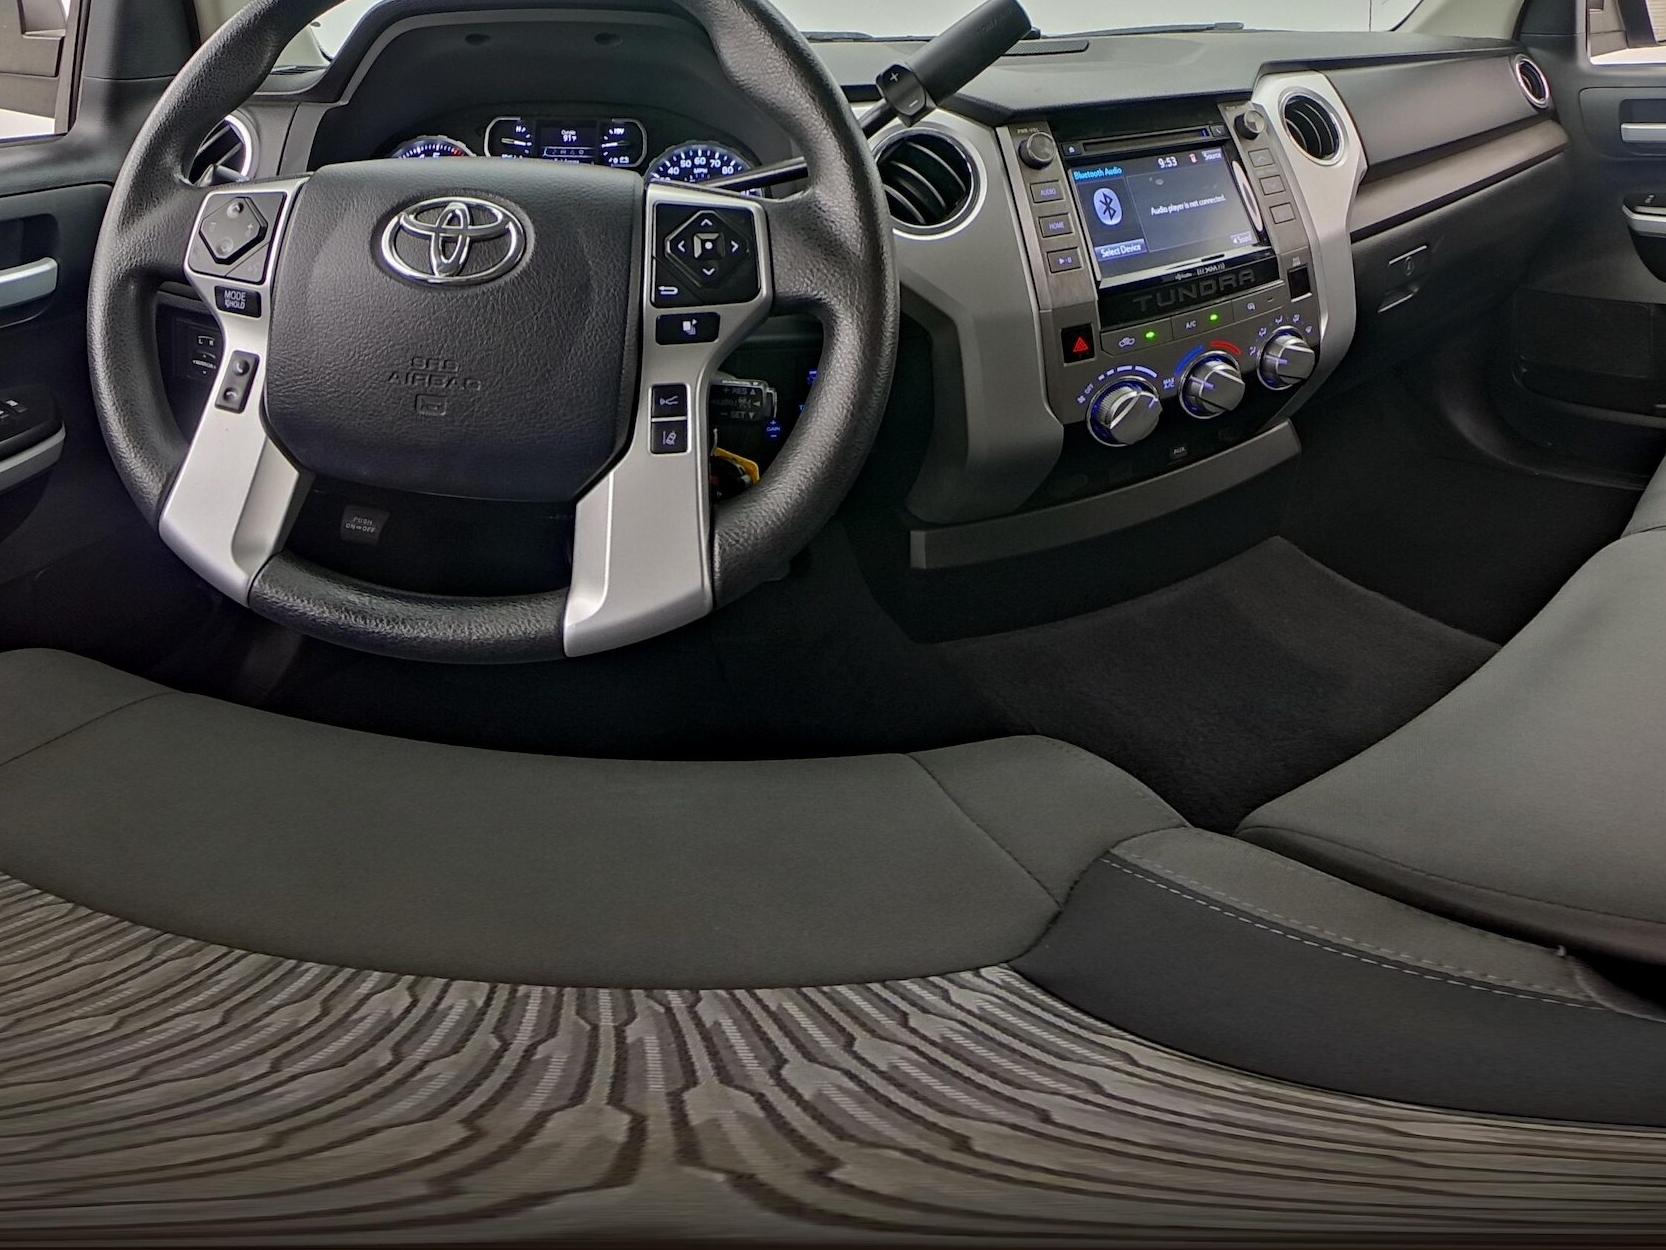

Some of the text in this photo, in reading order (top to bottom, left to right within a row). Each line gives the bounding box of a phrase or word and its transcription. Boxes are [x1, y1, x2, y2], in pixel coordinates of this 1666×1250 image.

[694, 156, 707, 165] 60
[1203, 152, 1222, 161] Source
[680, 160, 692, 168] 50
[709, 159, 721, 168] 70
[1158, 156, 1178, 169] 9:53
[667, 167, 680, 175] 40
[721, 166, 734, 175] 80
[1073, 166, 1123, 180] Bluetooth Audio
[1040, 188, 1057, 196] AUDIO
[1150, 205, 1168, 216] Audio
[1168, 202, 1185, 214] player
[1189, 199, 1199, 209] not
[1199, 194, 1227, 206] connected.
[1049, 221, 1065, 230] HOME
[1100, 243, 1142, 259] Select Device
[1133, 267, 1256, 312] TUNDRA
[224, 290, 247, 302] MODE
[230, 300, 246, 310] HOLD
[1185, 320, 1197, 330] A/C
[388, 371, 482, 391] AIRBAG
[1173, 446, 1186, 455] AUX
[352, 516, 373, 526] PUSH
